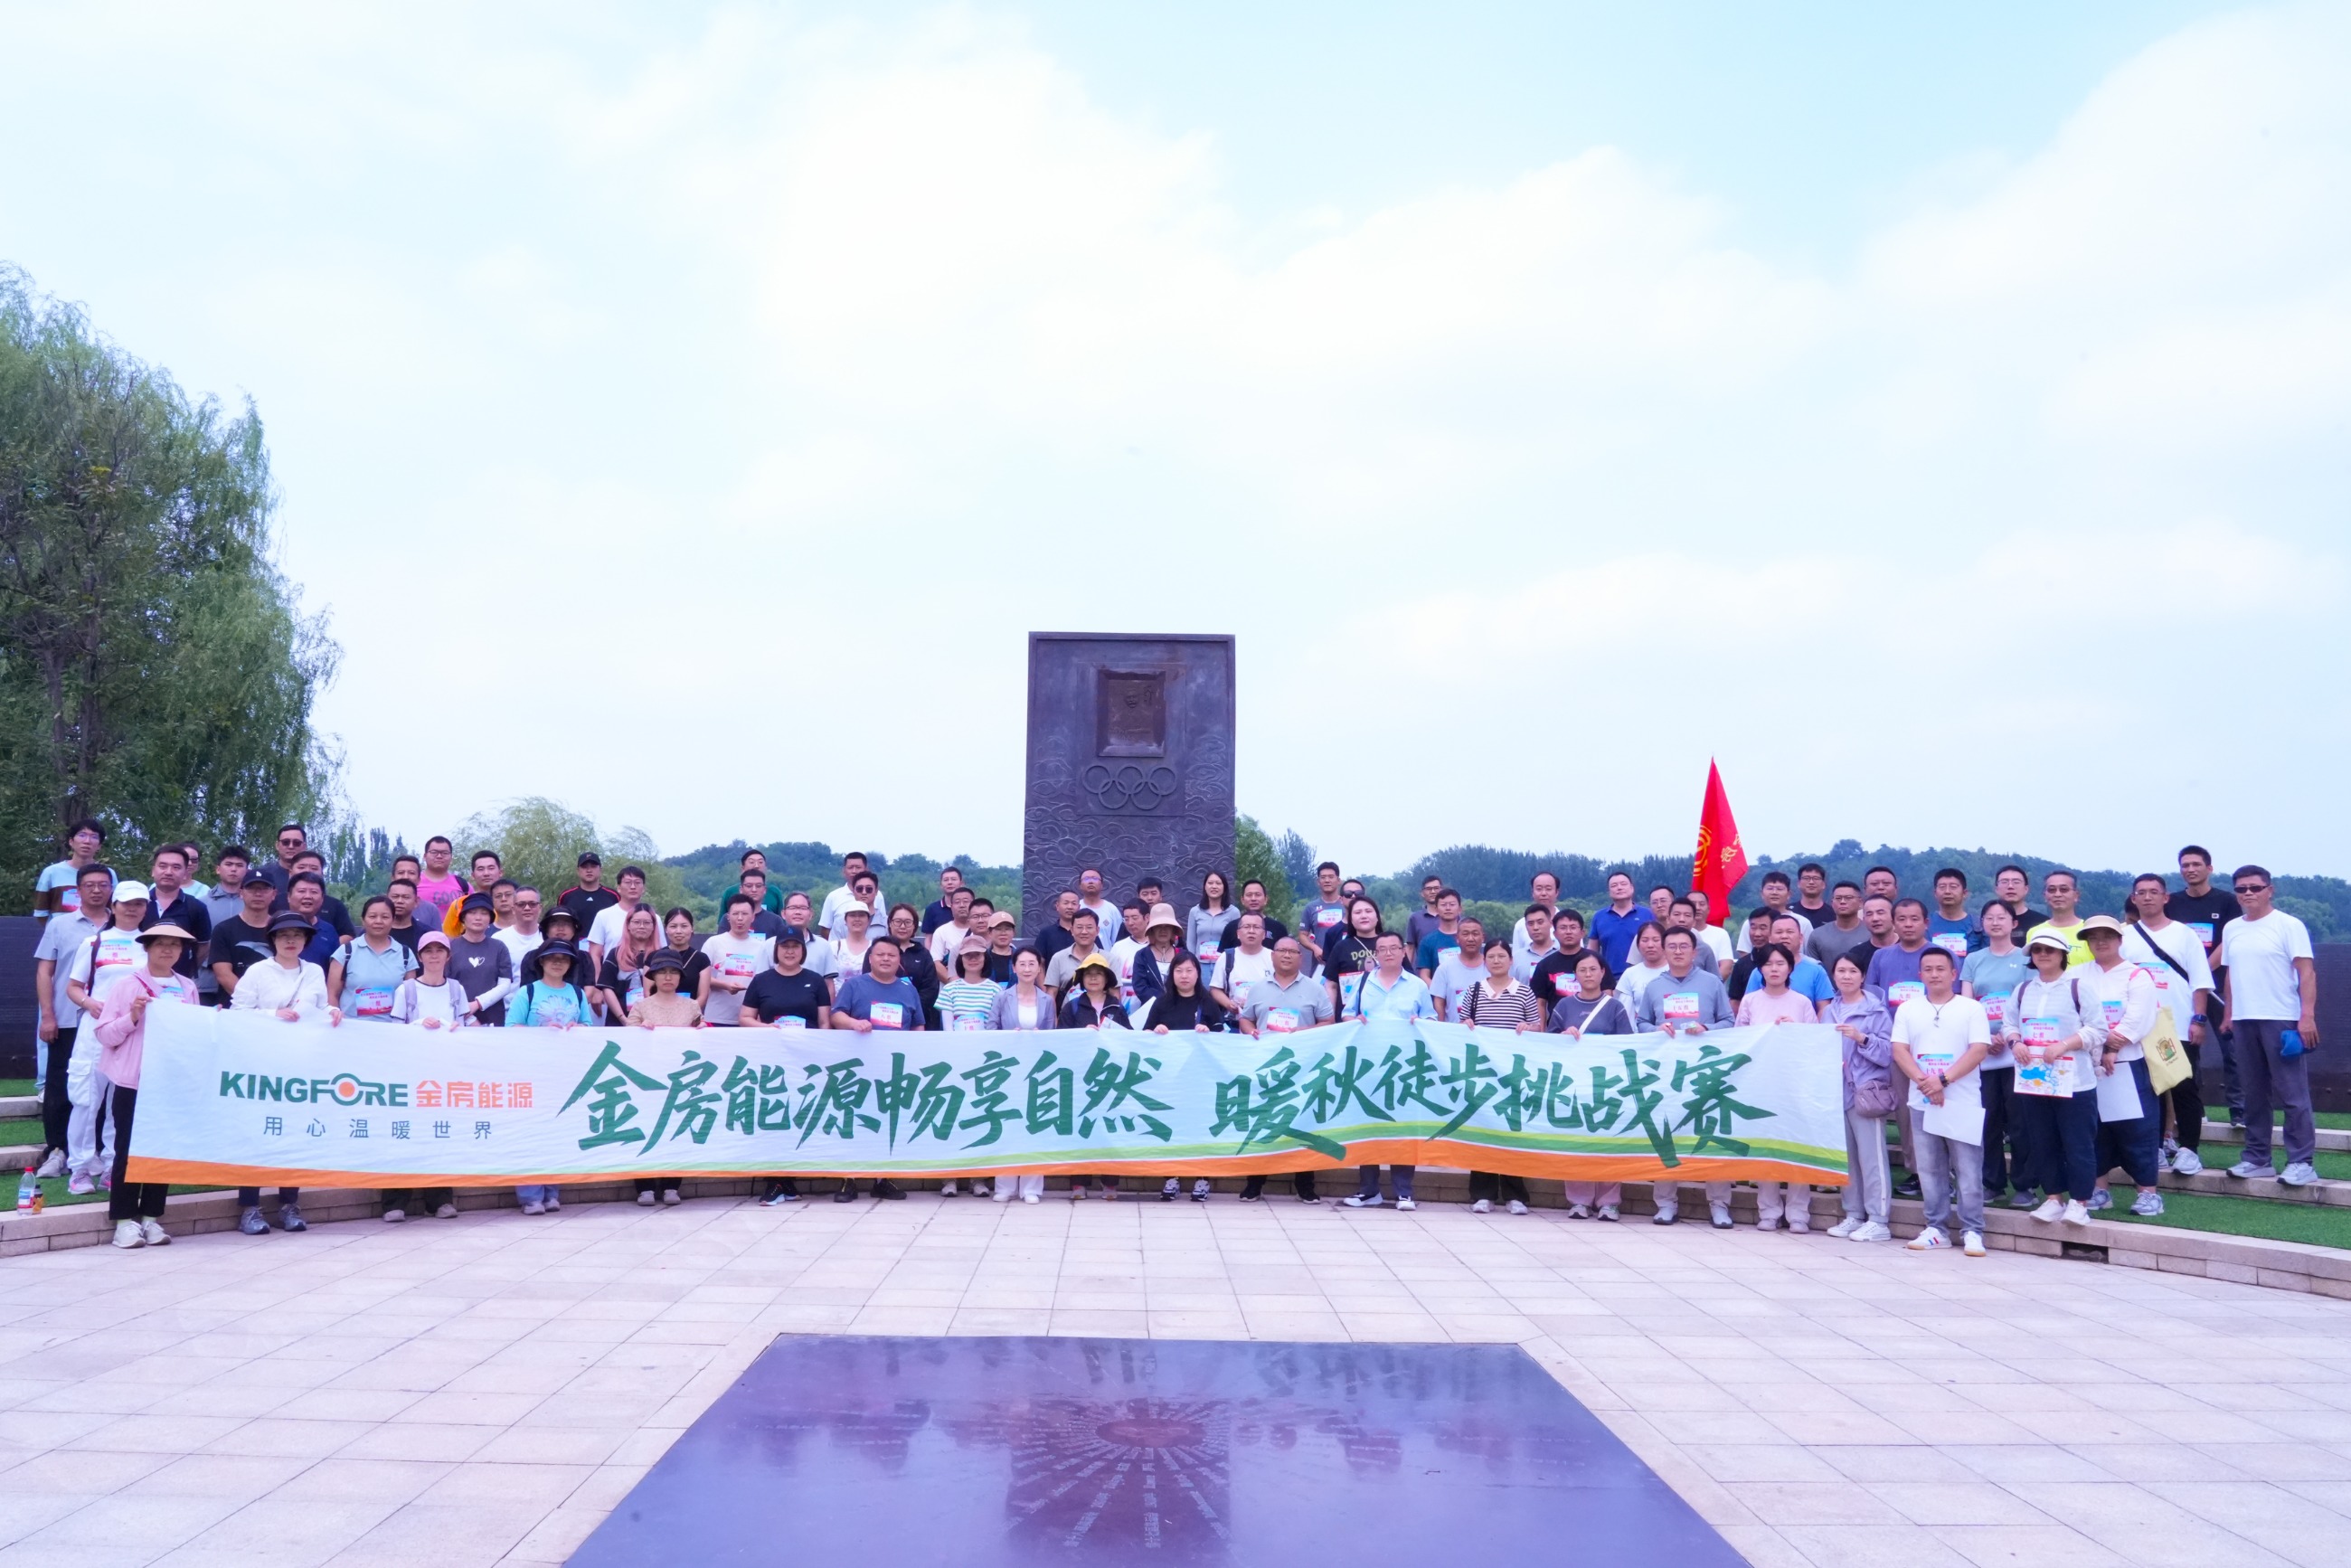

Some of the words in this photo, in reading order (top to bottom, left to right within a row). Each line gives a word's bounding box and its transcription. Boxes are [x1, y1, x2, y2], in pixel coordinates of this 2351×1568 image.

[220, 1071, 408, 1107] KINGFORE
[416, 1080, 533, 1109] 金房能源
[556, 1041, 1174, 1154] 金房能源畅享自然
[1209, 1040, 1776, 1167] 暖秋徒步挑战赛
[263, 1116, 493, 1141] 用心温暖世界
